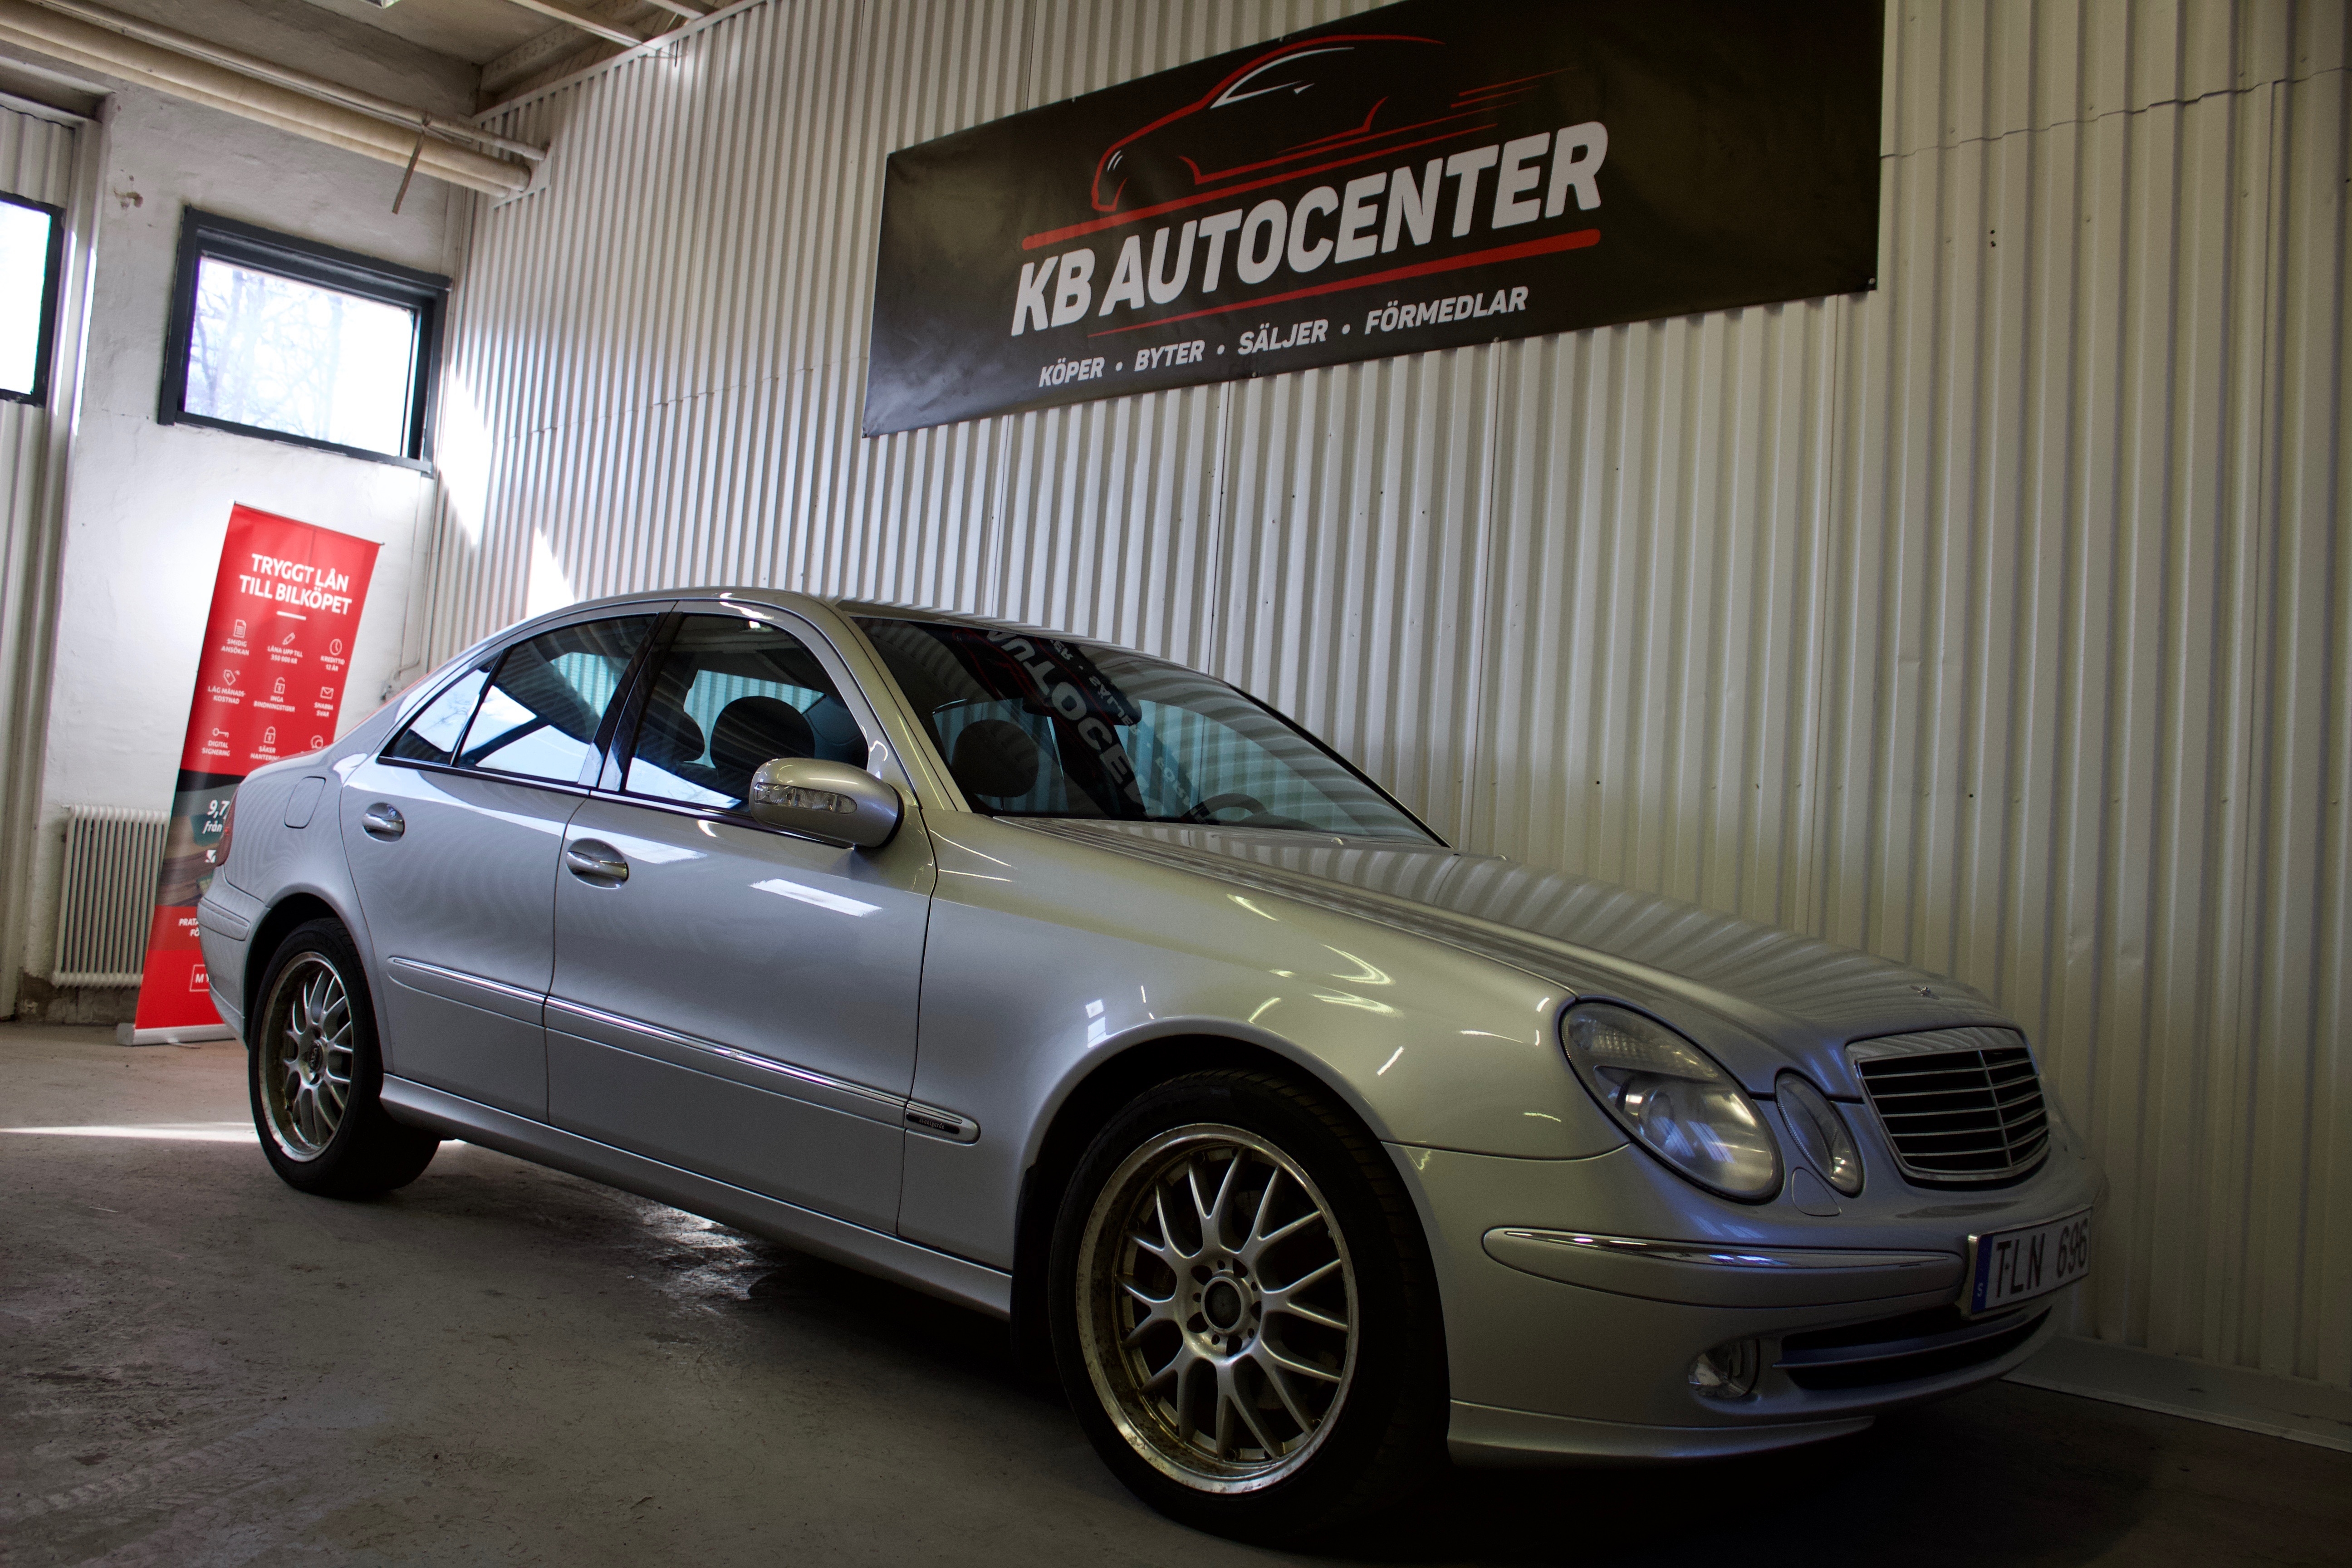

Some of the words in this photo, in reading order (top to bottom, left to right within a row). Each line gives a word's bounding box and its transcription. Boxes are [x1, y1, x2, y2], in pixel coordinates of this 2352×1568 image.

[1010, 248, 1096, 338] KB
[1098, 121, 1608, 318] AUTOCENTER
[1039, 356, 1105, 388] KÖPER
[1132, 339, 1206, 373] BYTER
[1237, 318, 1329, 356] SÄLJER
[1364, 286, 1529, 335] FÖRMEDLAR
[251, 553, 314, 584] TRYGGT
[314, 567, 349, 593] LÅN
[239, 574, 273, 599] TILL
[274, 582, 353, 615] BILKÖPET
[226, 637, 248, 647] SMIDIG
[220, 645, 250, 656] ANSÖKAN
[267, 645, 282, 654] LÅNA
[294, 650, 304, 658] TILL
[207, 685, 221, 694] LÅG
[213, 695, 240, 705] KOSTNAD
[270, 695, 284, 703] INGA
[253, 700, 296, 713] BINDNINGSTIDER
[313, 701, 334, 711] SNABBA
[316, 710, 330, 718] SVAR
[207, 740, 229, 749] DIGITAL
[201, 747, 230, 757] SIGNERING
[207, 799, 230, 820] 9,7
[201, 820, 223, 834] från
[918, 1117, 945, 1129] Avantgarde
[1976, 1282, 1984, 1297] S
[1996, 1233, 2045, 1298] TLN
[2056, 1217, 2088, 1278] 696
